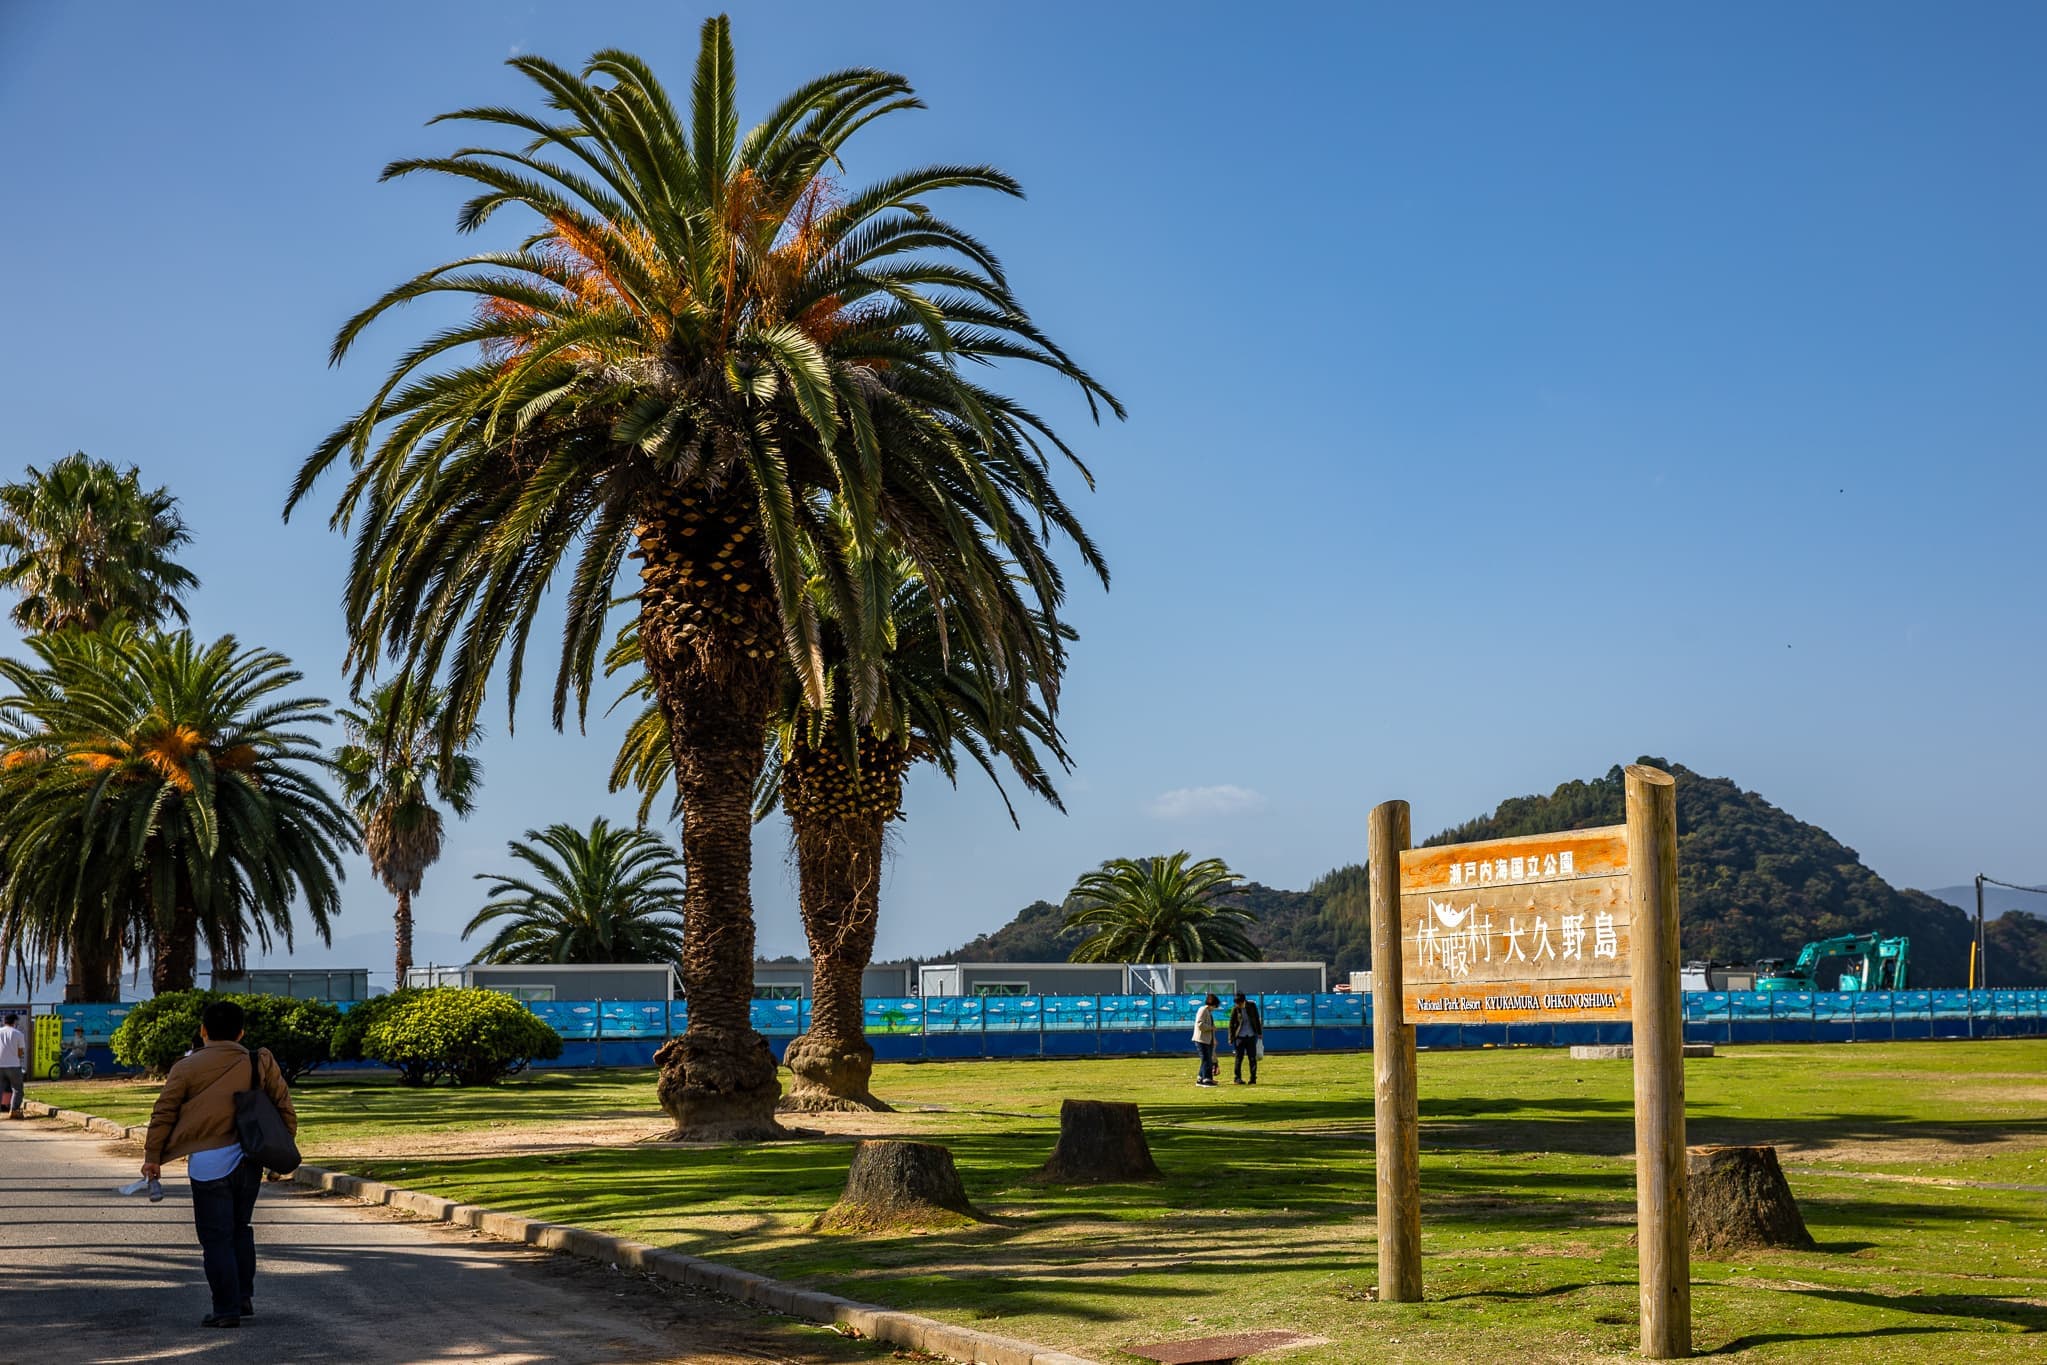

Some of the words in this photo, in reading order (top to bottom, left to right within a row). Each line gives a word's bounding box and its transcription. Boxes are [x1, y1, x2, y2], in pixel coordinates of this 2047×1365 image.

[1449, 851, 1574, 885] 瀬戸内海国立公園
[1417, 998, 1444, 1011] National
[1444, 997, 1461, 1011] Park
[1461, 997, 1482, 1010] Resort
[1485, 995, 1541, 1010] KYUKAMURA
[1543, 993, 1617, 1009] OHKUNOSHIMA
